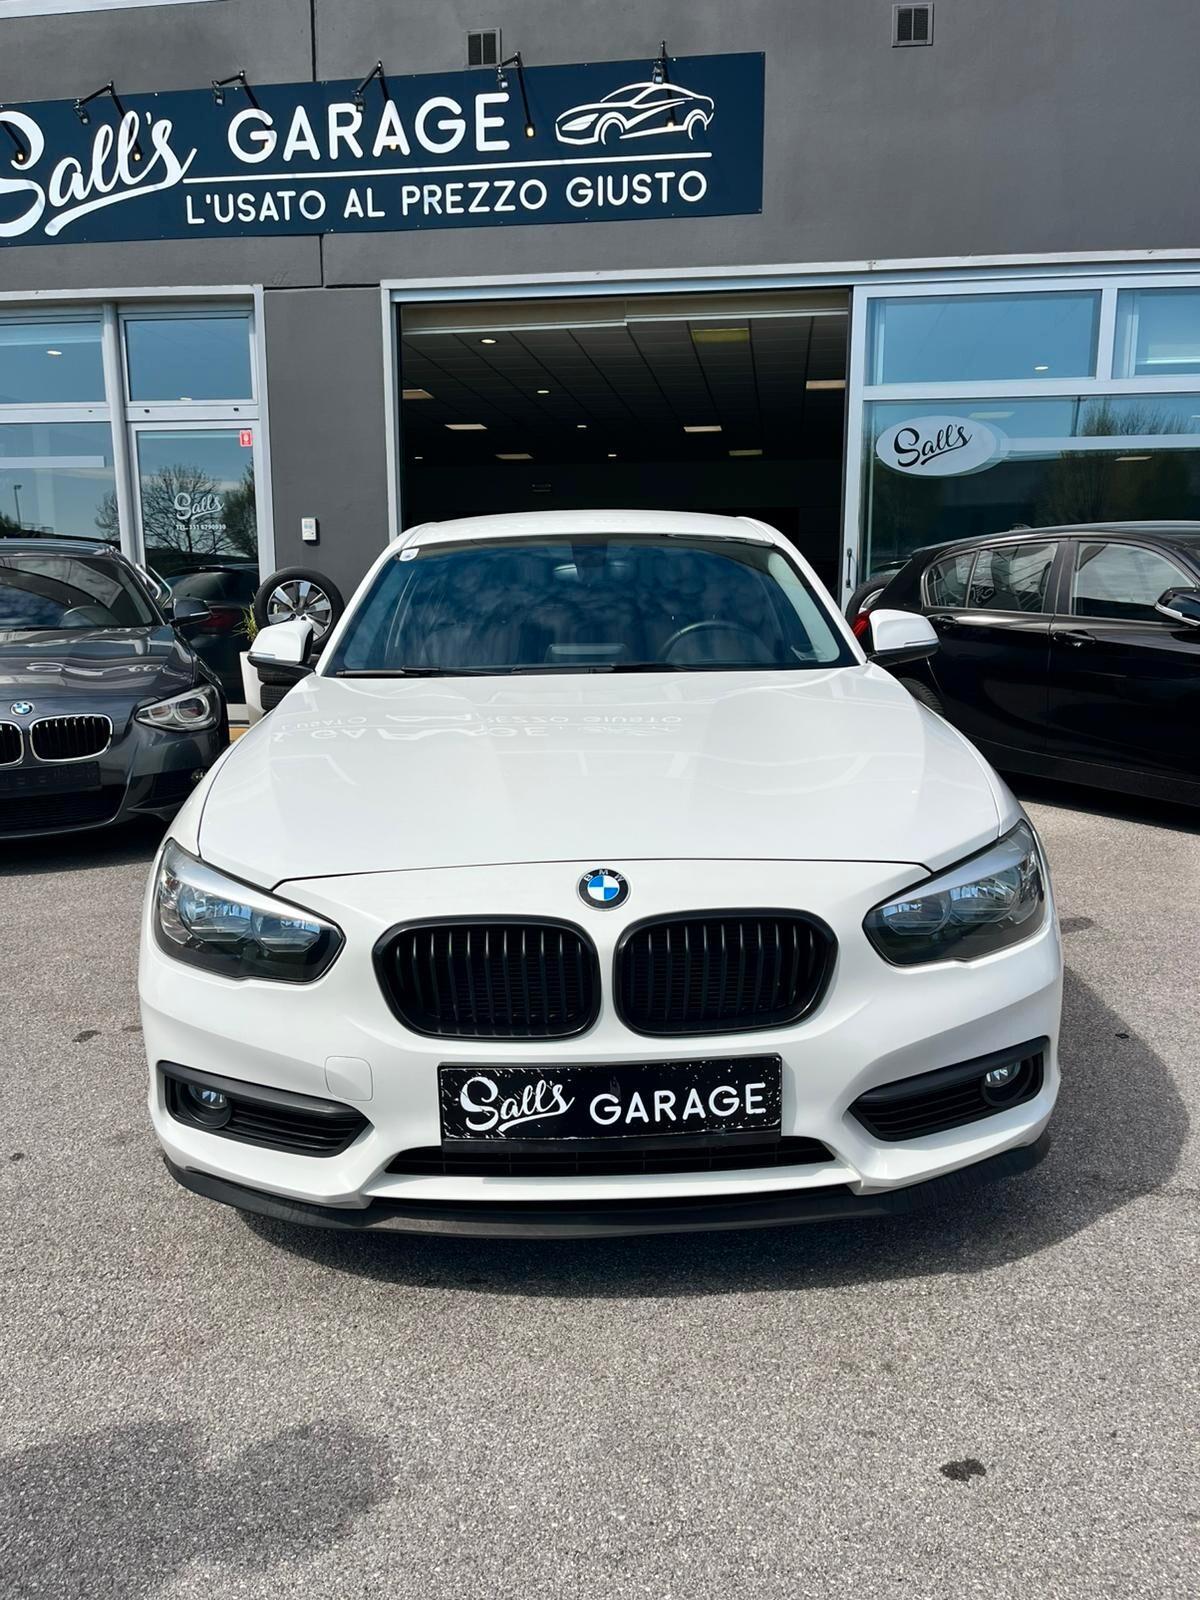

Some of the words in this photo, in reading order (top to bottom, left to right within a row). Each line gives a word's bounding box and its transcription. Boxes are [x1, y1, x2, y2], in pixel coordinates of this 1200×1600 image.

[228, 92, 510, 163] GARAGE
[186, 189, 326, 224] L'USATO
[343, 187, 385, 218] AL
[402, 179, 547, 215] PREZZO
[566, 170, 708, 207] GIUSTO
[893, 424, 973, 467] Sall's
[460, 1076, 576, 1132] Sall's
[589, 1083, 766, 1125] GARAGE
